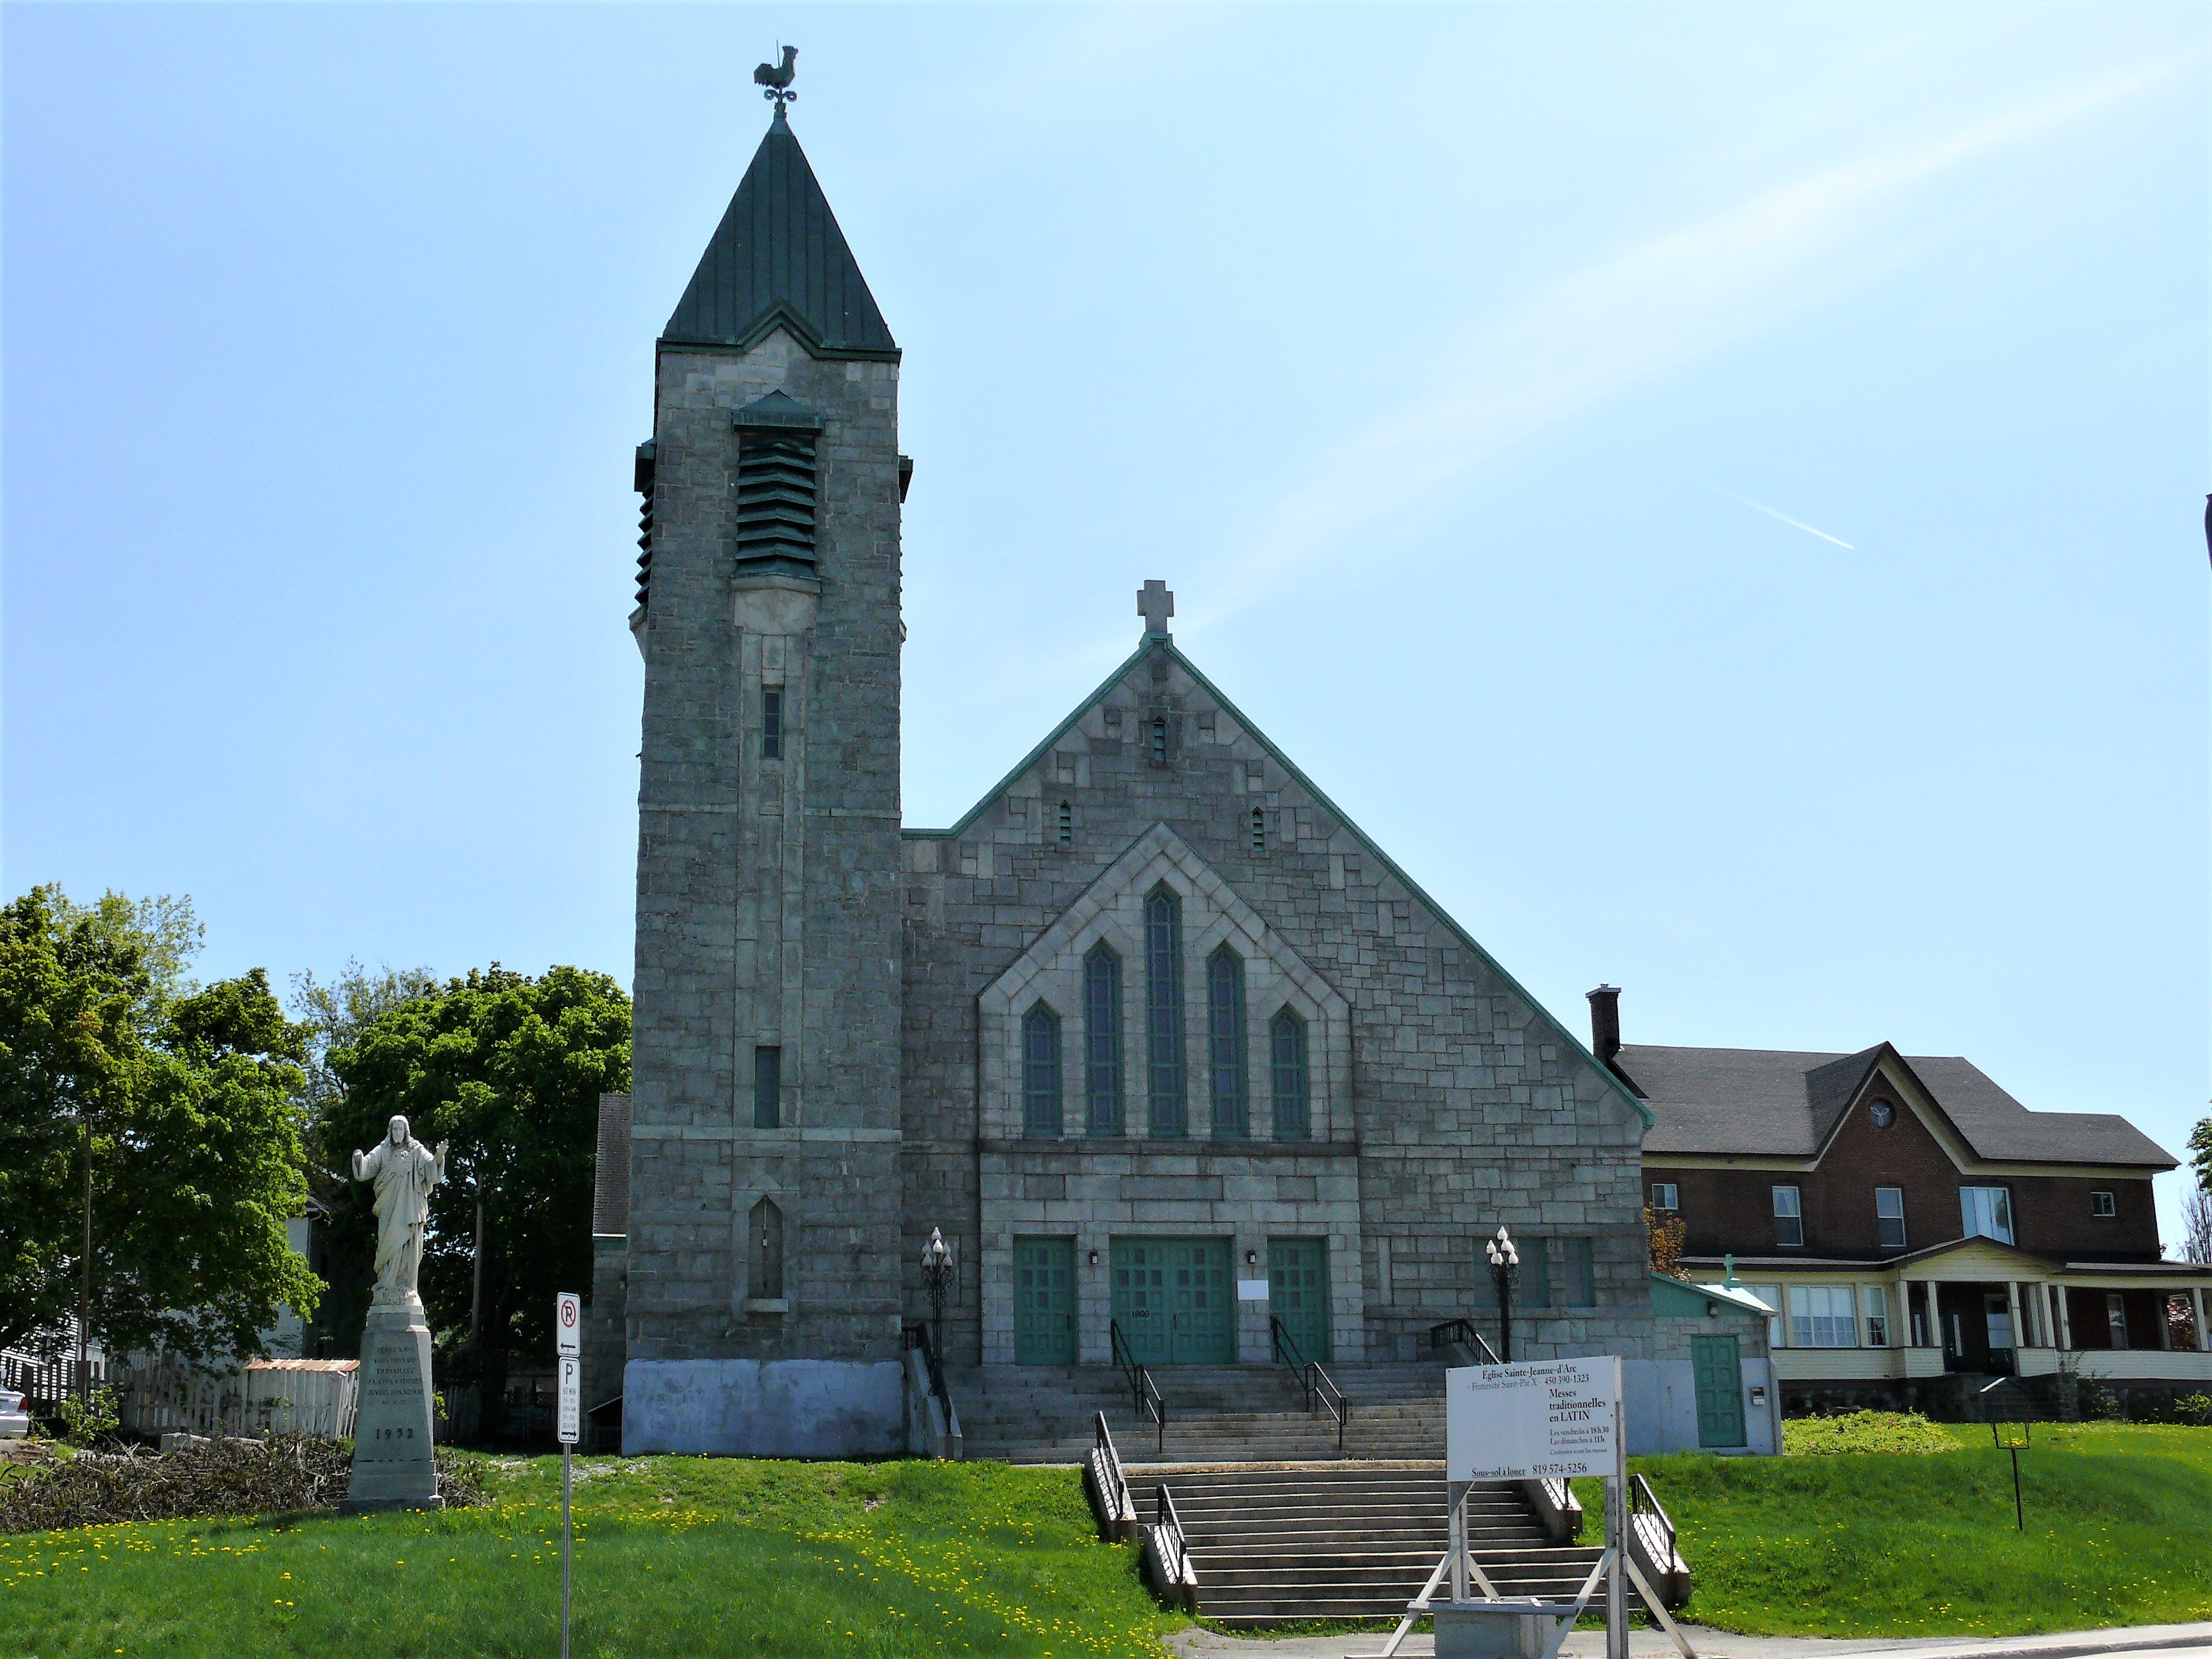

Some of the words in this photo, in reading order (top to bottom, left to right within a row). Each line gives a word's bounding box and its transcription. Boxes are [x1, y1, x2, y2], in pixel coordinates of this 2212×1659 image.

[566, 1363, 573, 1384] P
[1504, 1364, 1577, 1378] Sainte-Jeanne-d'Arc
[1532, 1378, 1537, 1386] X
[1544, 1376, 1557, 1385] 450
[1558, 1373, 1589, 1384] 390-1323
[1549, 1389, 1577, 1398] Messes
[1549, 1398, 1606, 1410] traditionnelles
[1561, 1410, 1590, 1421] LATIN
[1472, 1467, 1501, 1476] Sous-sol
[1508, 1467, 1526, 1475] louer
[1532, 1464, 1547, 1475] 819
[1549, 1463, 1587, 1474] 574-5256
